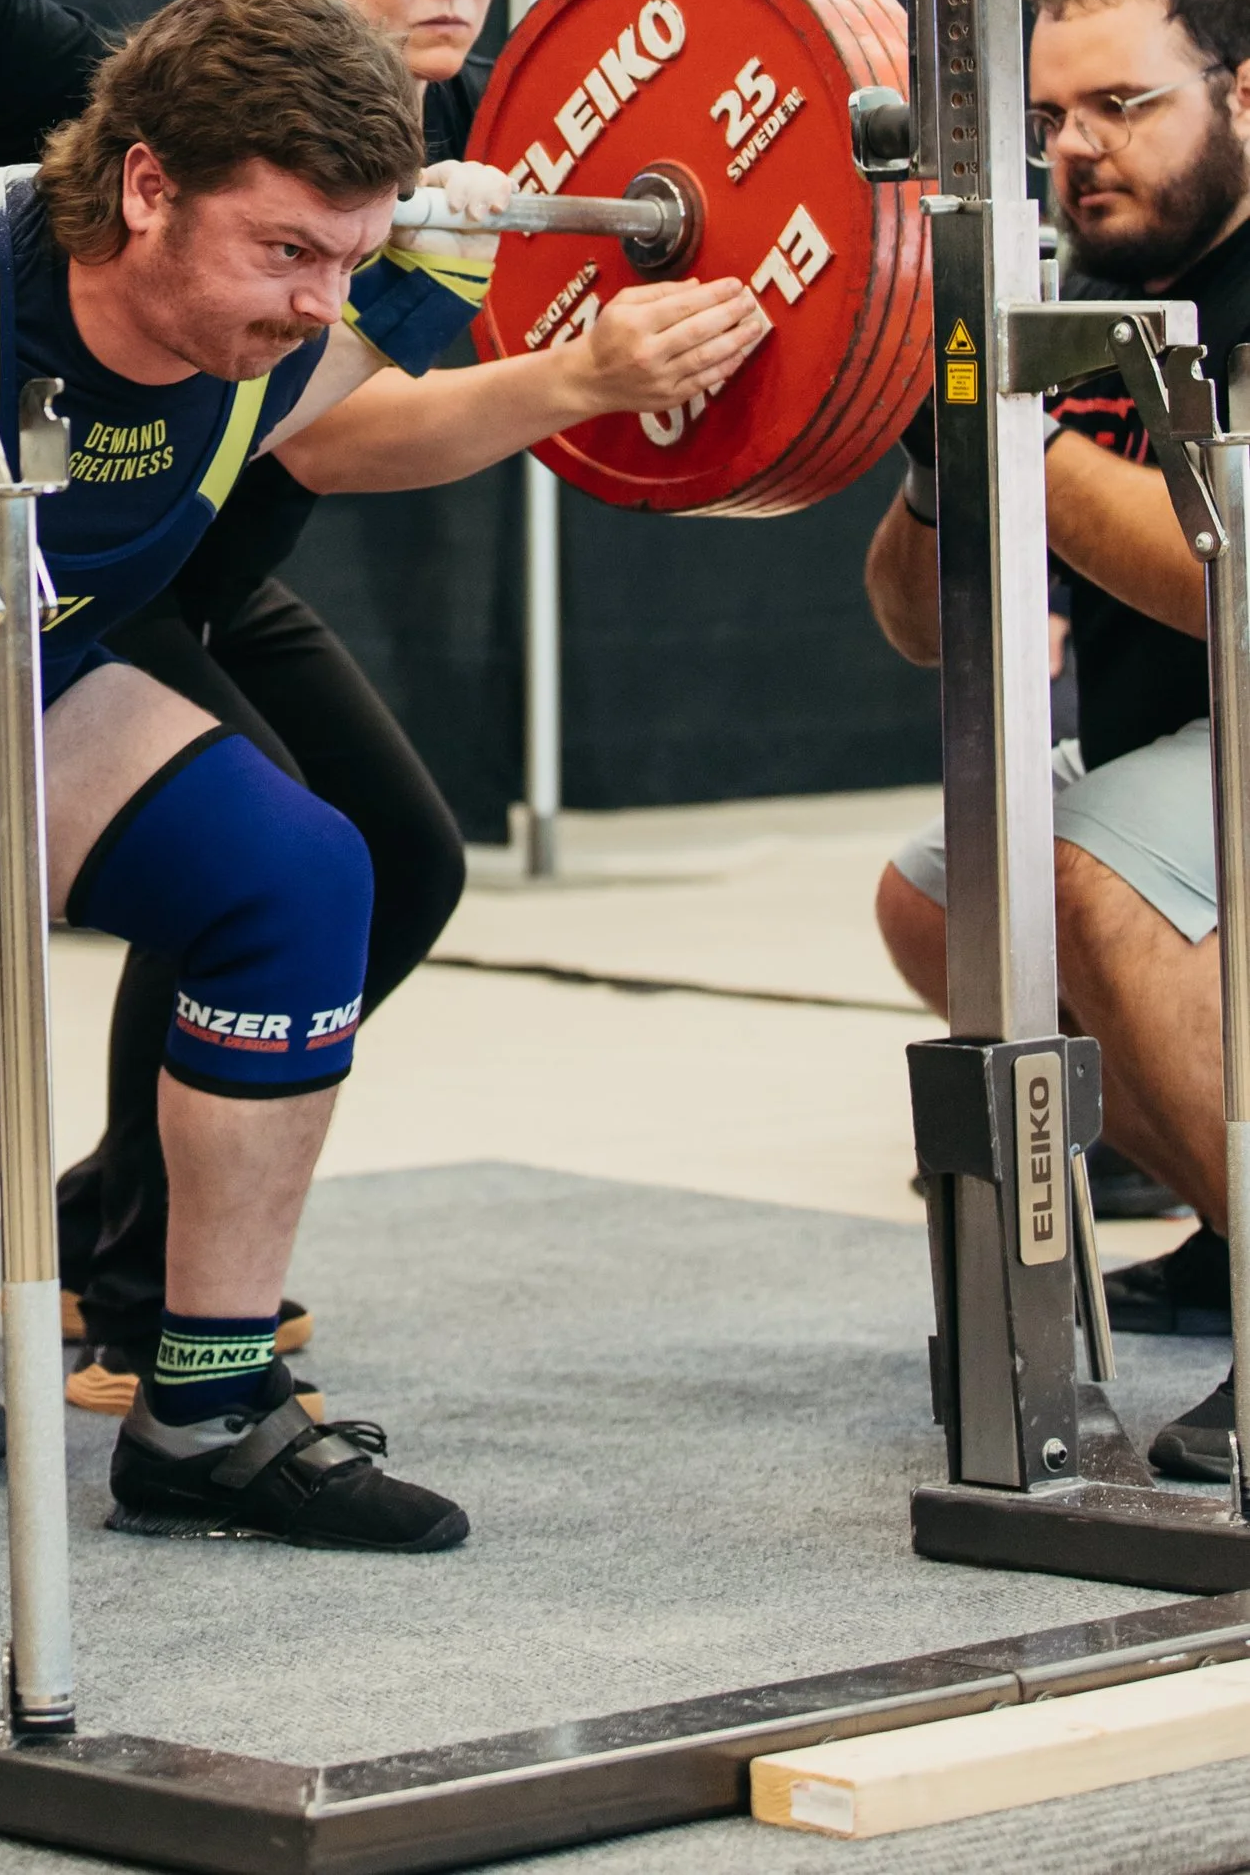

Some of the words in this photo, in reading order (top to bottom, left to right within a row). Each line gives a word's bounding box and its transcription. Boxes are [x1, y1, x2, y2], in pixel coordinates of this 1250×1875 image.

[709, 55, 777, 150] 25
[726, 86, 805, 184] SWEDEN
[83, 419, 166, 454] DEMAND
[68, 445, 174, 483] GREATNESS
[176, 990, 292, 1040] INZER
[1028, 1076, 1054, 1242] ELEIKO
[159, 1342, 259, 1366] DEMAND
